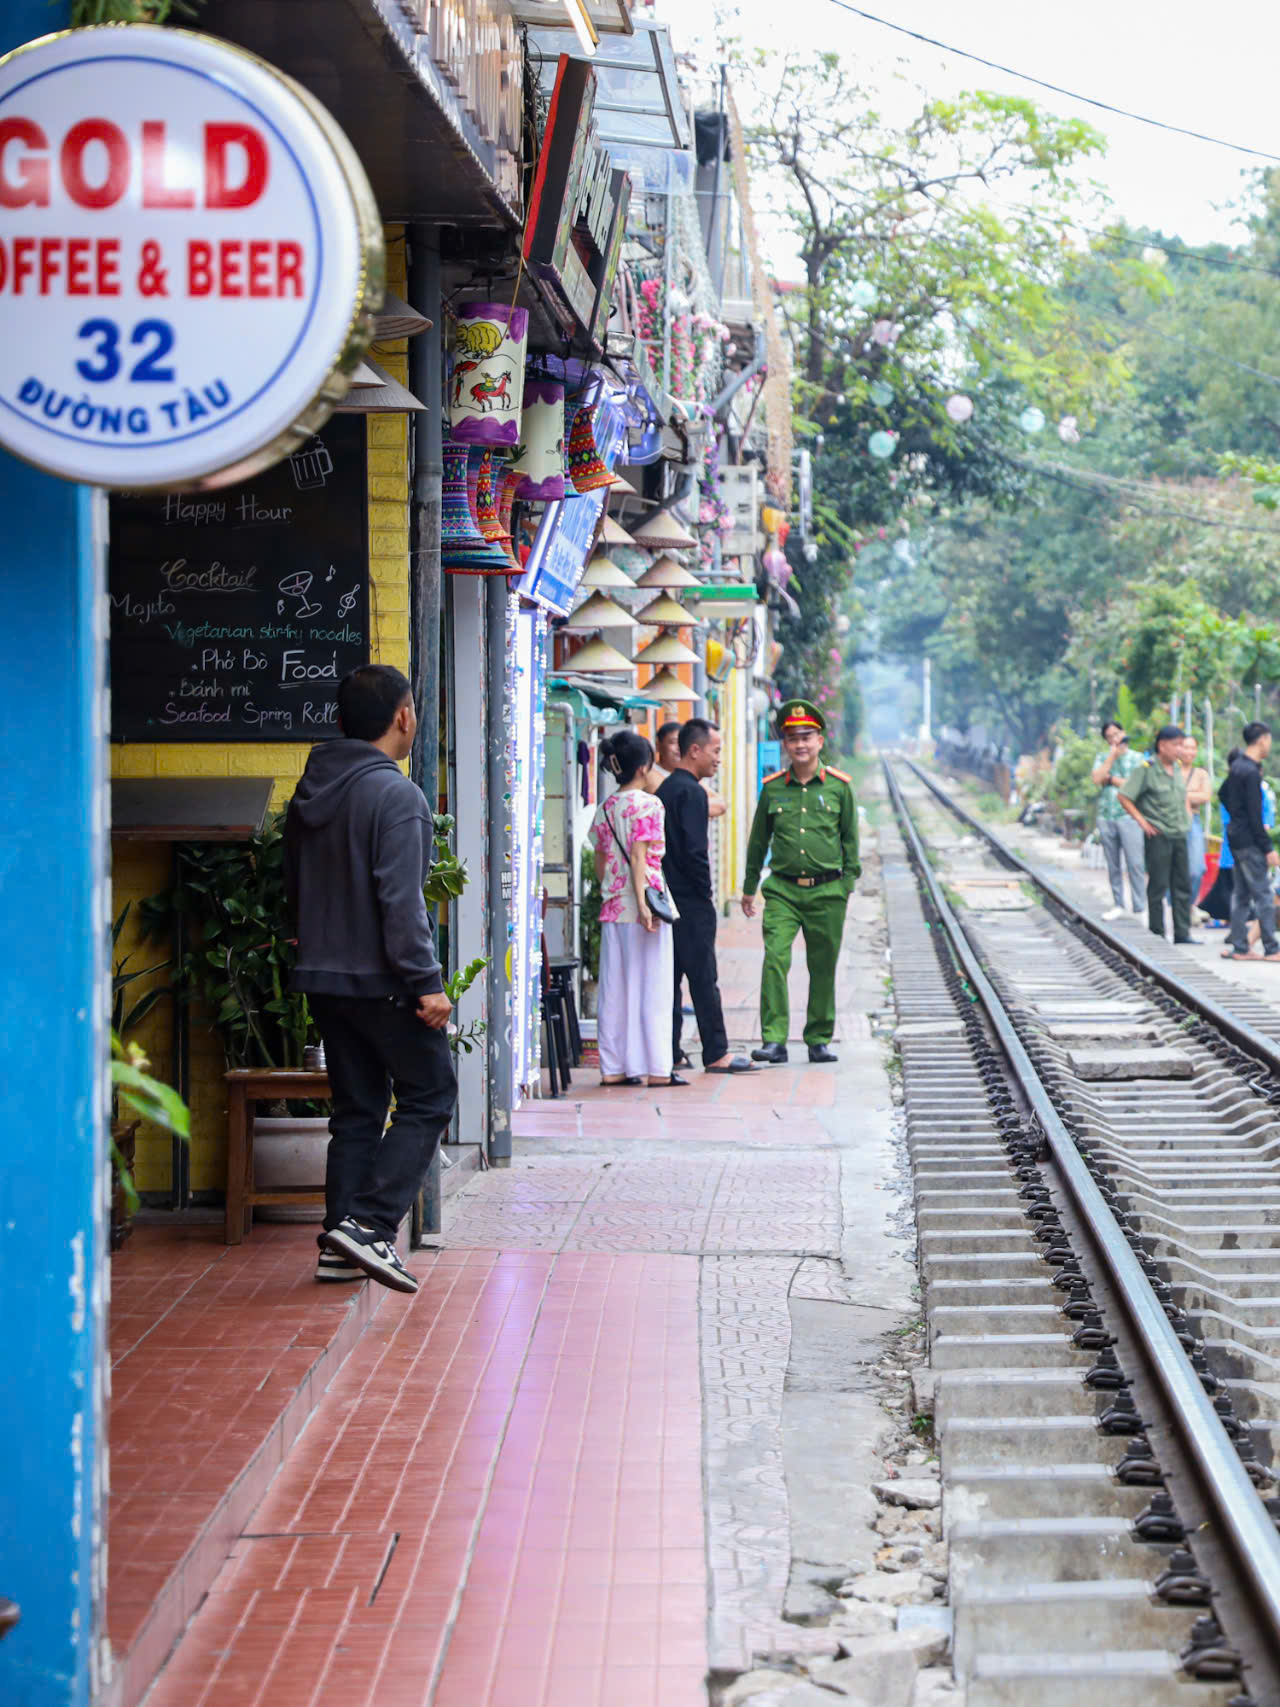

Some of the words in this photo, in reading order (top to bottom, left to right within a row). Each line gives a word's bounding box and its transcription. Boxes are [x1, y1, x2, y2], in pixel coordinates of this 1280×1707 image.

[0, 117, 269, 210] GOLD
[138, 238, 169, 297] &
[187, 240, 304, 298] BEER
[76, 318, 175, 383] 32
[18, 377, 149, 434] ĐƯỜNG
[160, 379, 231, 429] TÀU
[162, 493, 226, 527] Happy
[235, 494, 292, 521] Hour
[160, 558, 257, 588] Cocktail
[110, 593, 176, 624] Mojito
[310, 624, 362, 646] noodles
[202, 648, 236, 671] Phở
[243, 648, 268, 670] Bò
[281, 650, 337, 681] Food
[180, 678, 224, 697] Bánh
[159, 702, 231, 724] Seafood
[242, 702, 293, 730] Spring
[302, 701, 339, 724] Roll
